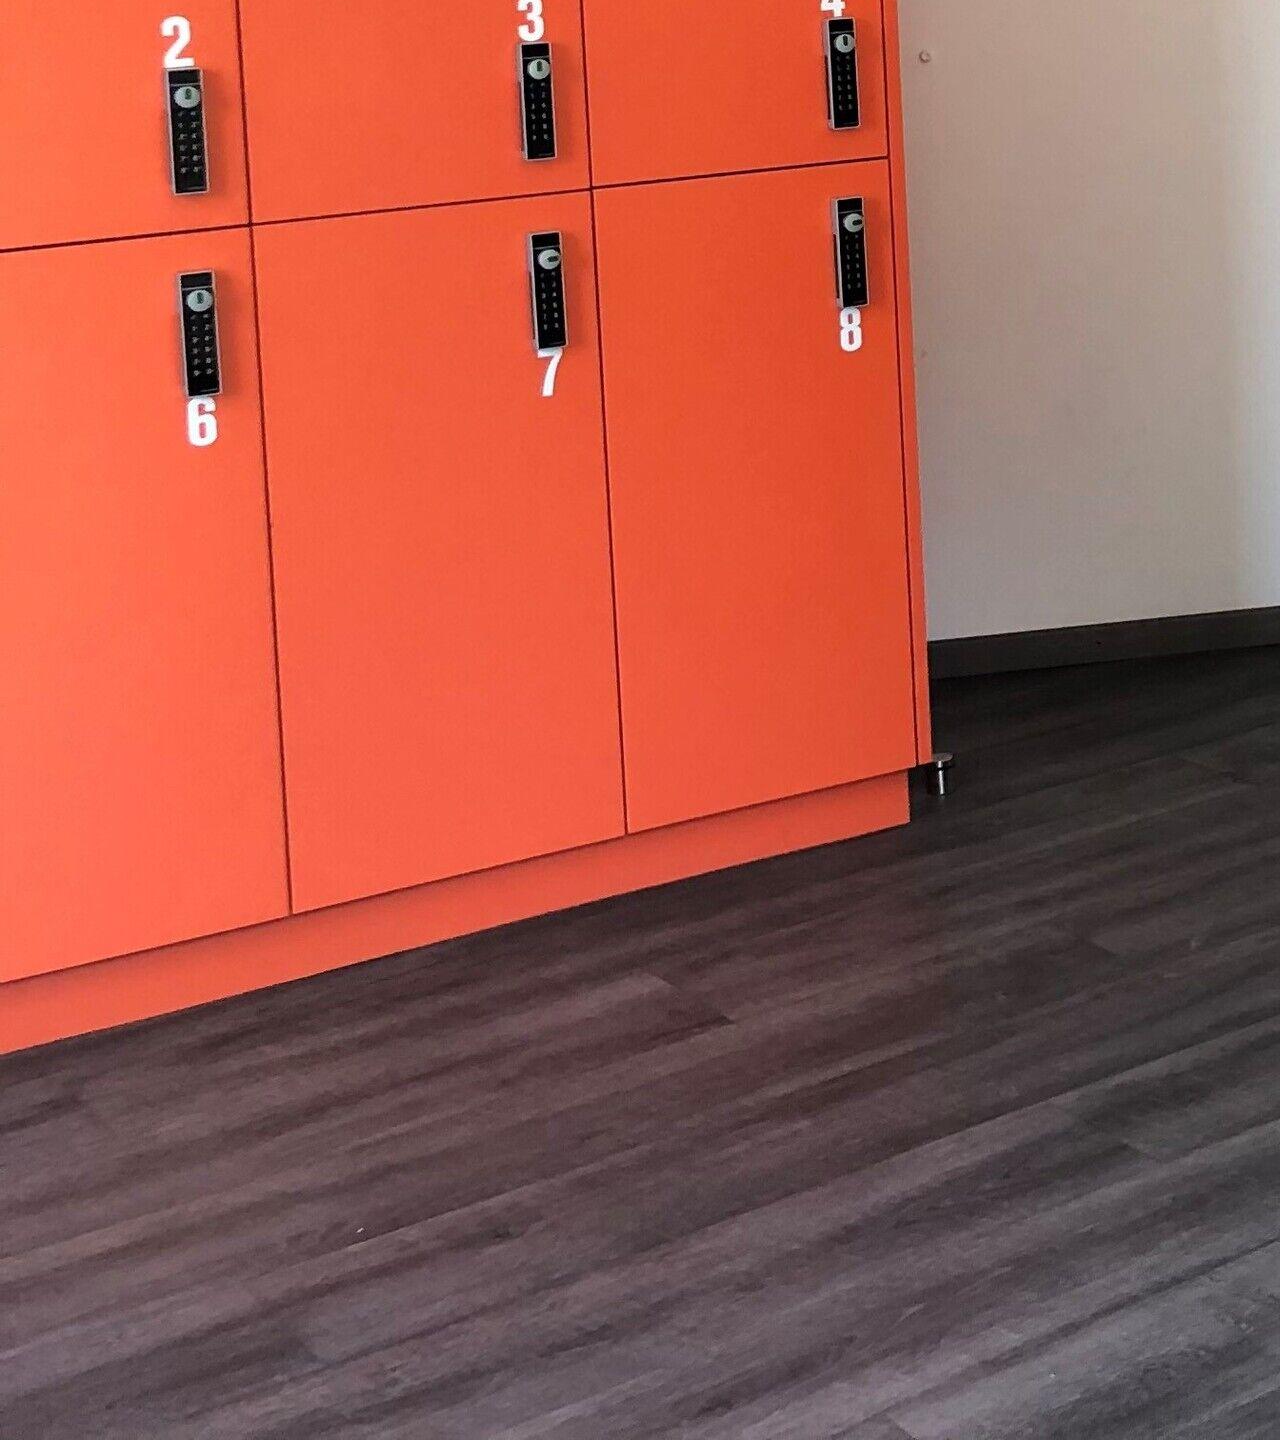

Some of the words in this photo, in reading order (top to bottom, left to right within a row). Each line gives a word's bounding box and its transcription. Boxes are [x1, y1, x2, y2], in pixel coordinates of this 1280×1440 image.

[160, 15, 196, 69] 2
[839, 307, 863, 352] 8
[537, 348, 563, 397] 7
[186, 397, 218, 448] 6
